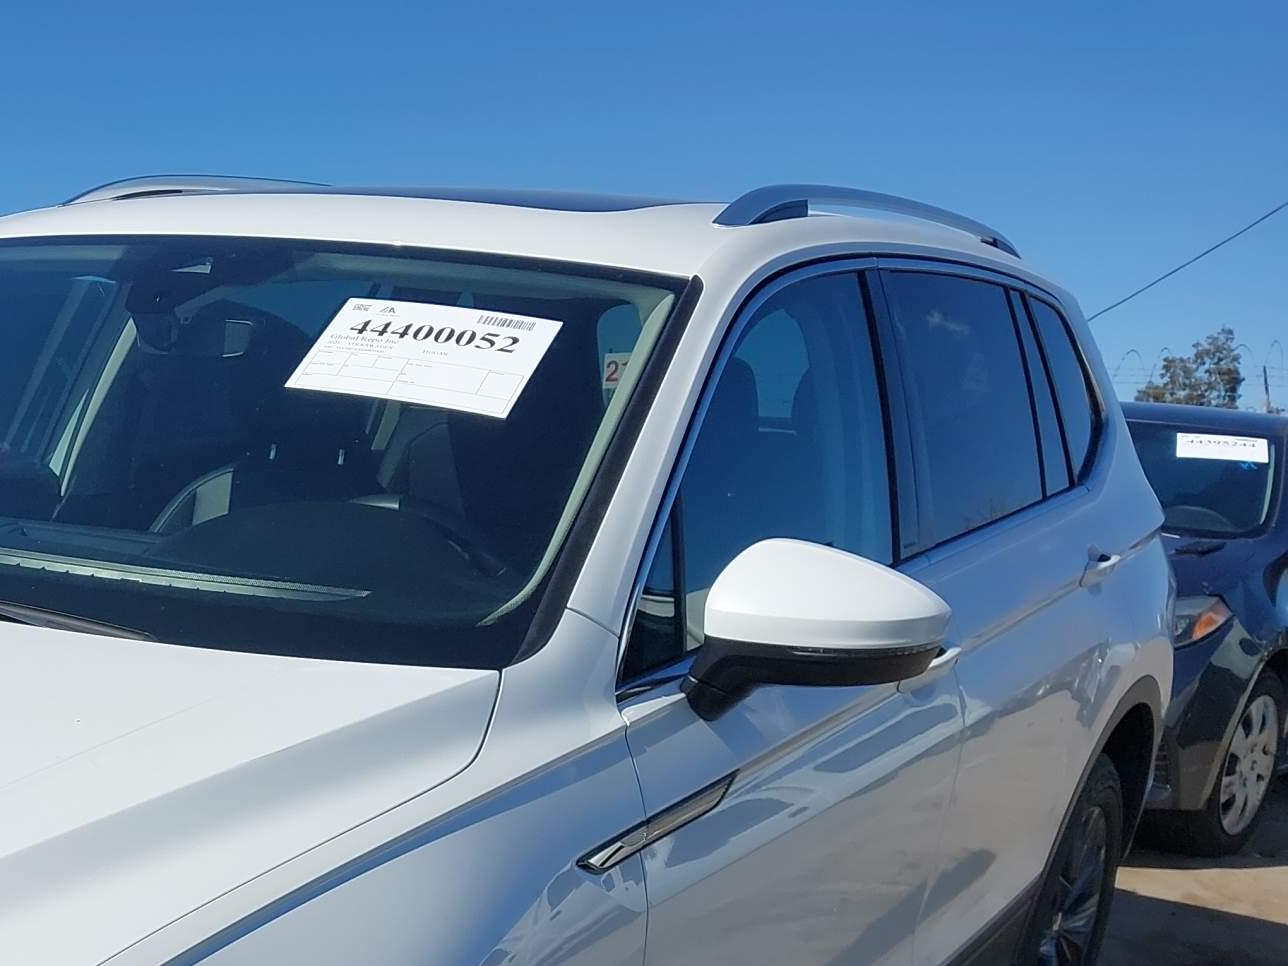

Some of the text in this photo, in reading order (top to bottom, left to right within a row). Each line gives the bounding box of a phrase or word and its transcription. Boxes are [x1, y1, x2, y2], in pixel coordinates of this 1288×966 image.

[329, 333, 360, 342] Global
[360, 336, 383, 344] Repo
[350, 319, 521, 354] 44400052
